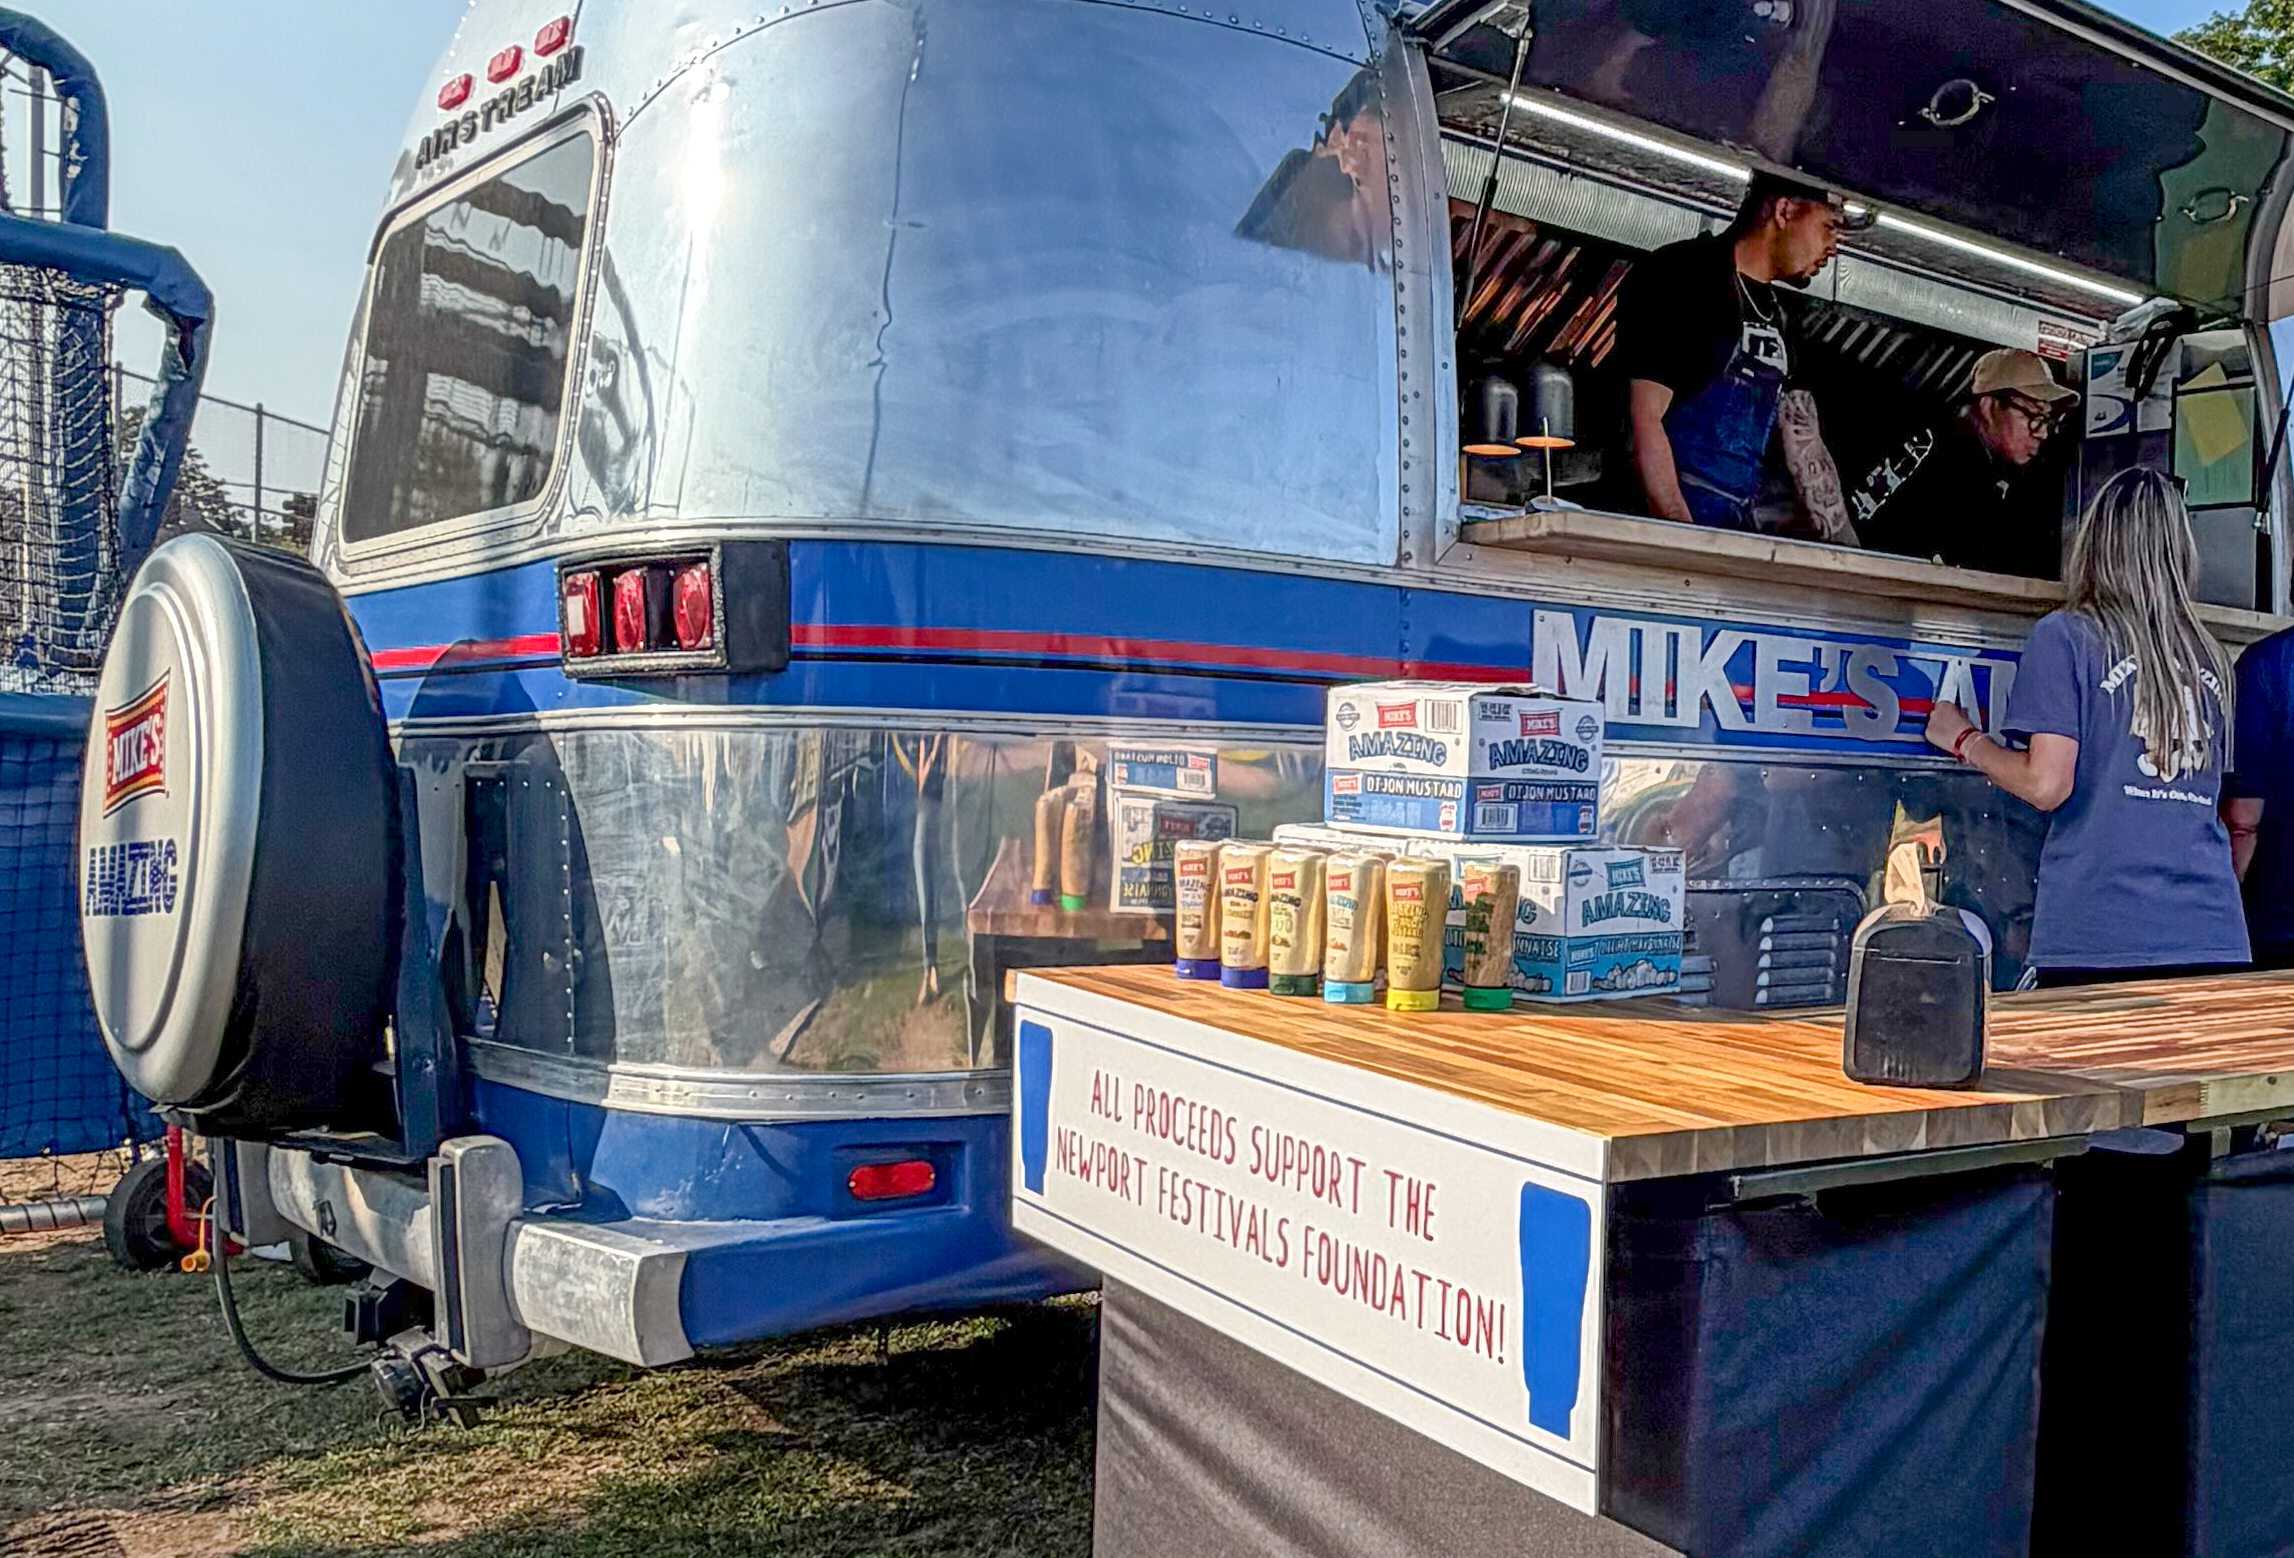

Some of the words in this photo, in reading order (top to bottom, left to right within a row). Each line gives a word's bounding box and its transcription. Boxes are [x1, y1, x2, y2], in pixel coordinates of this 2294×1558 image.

[414, 45, 585, 170] AIRSTREAM
[112, 715, 161, 786] MIKE'S
[1349, 731, 1447, 767] AMAZING
[1489, 738, 1589, 773] AMAZING
[1367, 776, 1403, 795] DIJON
[1406, 778, 1462, 799] MUSTARD
[1508, 784, 1544, 801] DIJON
[1546, 785, 1596, 801] MUSTARD
[85, 838, 177, 916] AMAZING
[1582, 892, 1671, 927] AMAZING
[1090, 1069, 1123, 1123] ALL
[1133, 1082, 1237, 1166] PROCEEDS
[1249, 1125, 1366, 1215] SUPPORT
[1383, 1168, 1437, 1243] THE
[1056, 1125, 1148, 1206] NEWPORT
[1158, 1166, 1290, 1268] FESTIVALS
[1303, 1225, 1507, 1365] FOUNDATION!
